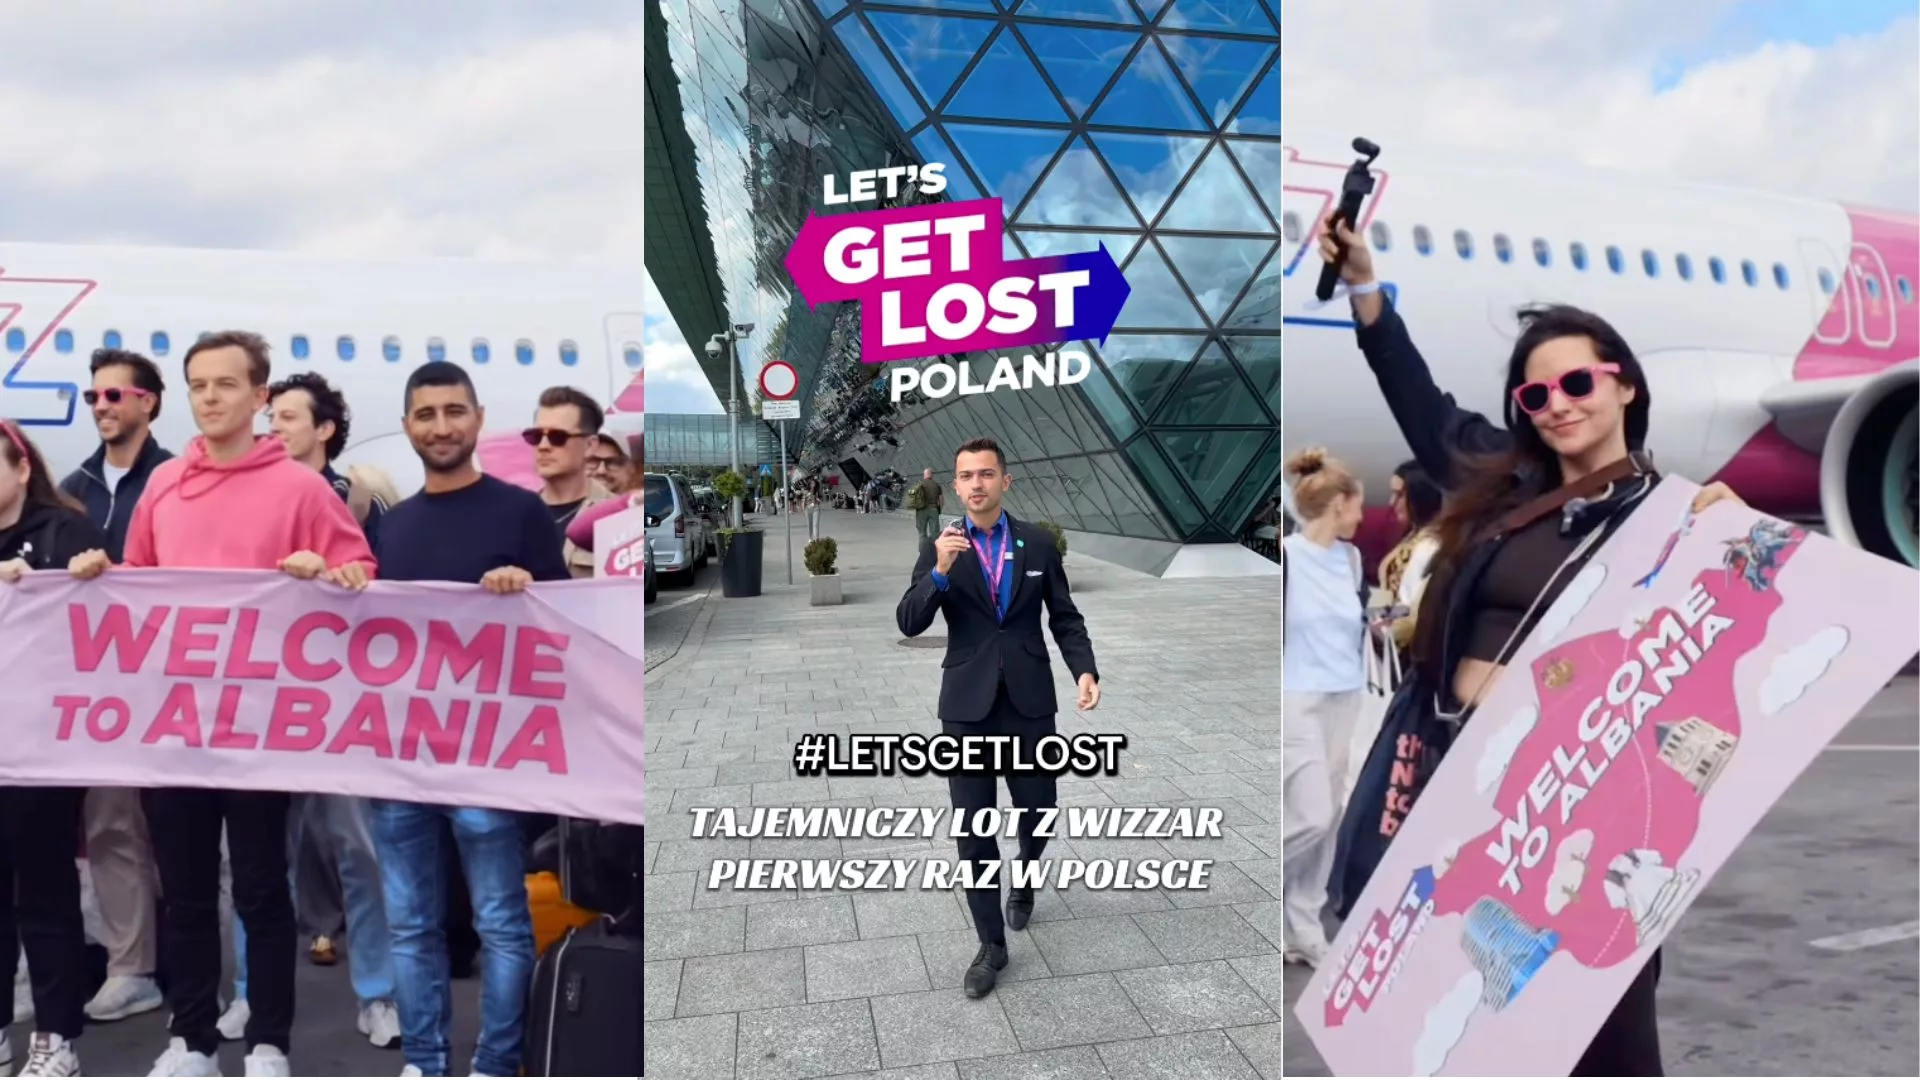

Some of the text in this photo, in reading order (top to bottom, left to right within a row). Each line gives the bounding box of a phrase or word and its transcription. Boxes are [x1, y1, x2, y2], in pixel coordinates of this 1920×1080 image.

[68, 603, 570, 699] WELCOME
[52, 683, 568, 775] TO ALBANIA
[1486, 583, 1718, 866] WELCOME
[1498, 613, 1735, 895] TO ALBANIA
[1333, 920, 1381, 1010] GET
[1357, 880, 1422, 1000] LOST
